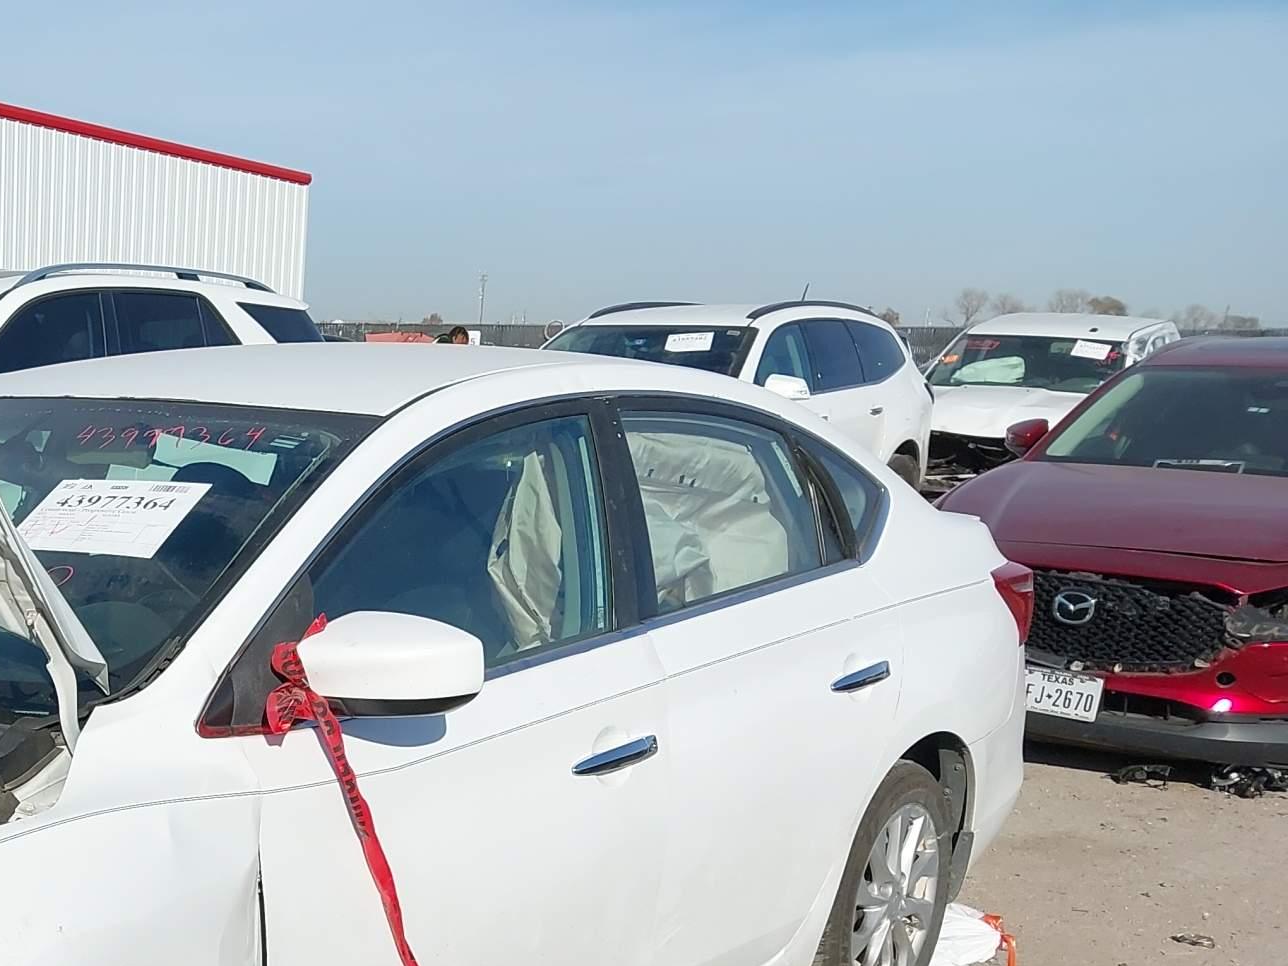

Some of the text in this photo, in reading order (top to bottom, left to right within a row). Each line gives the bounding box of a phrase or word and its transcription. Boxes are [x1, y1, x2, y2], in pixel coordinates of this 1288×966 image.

[77, 425, 265, 450] 43977364
[56, 495, 177, 512] 43977364
[1041, 673, 1074, 686] TEXAS
